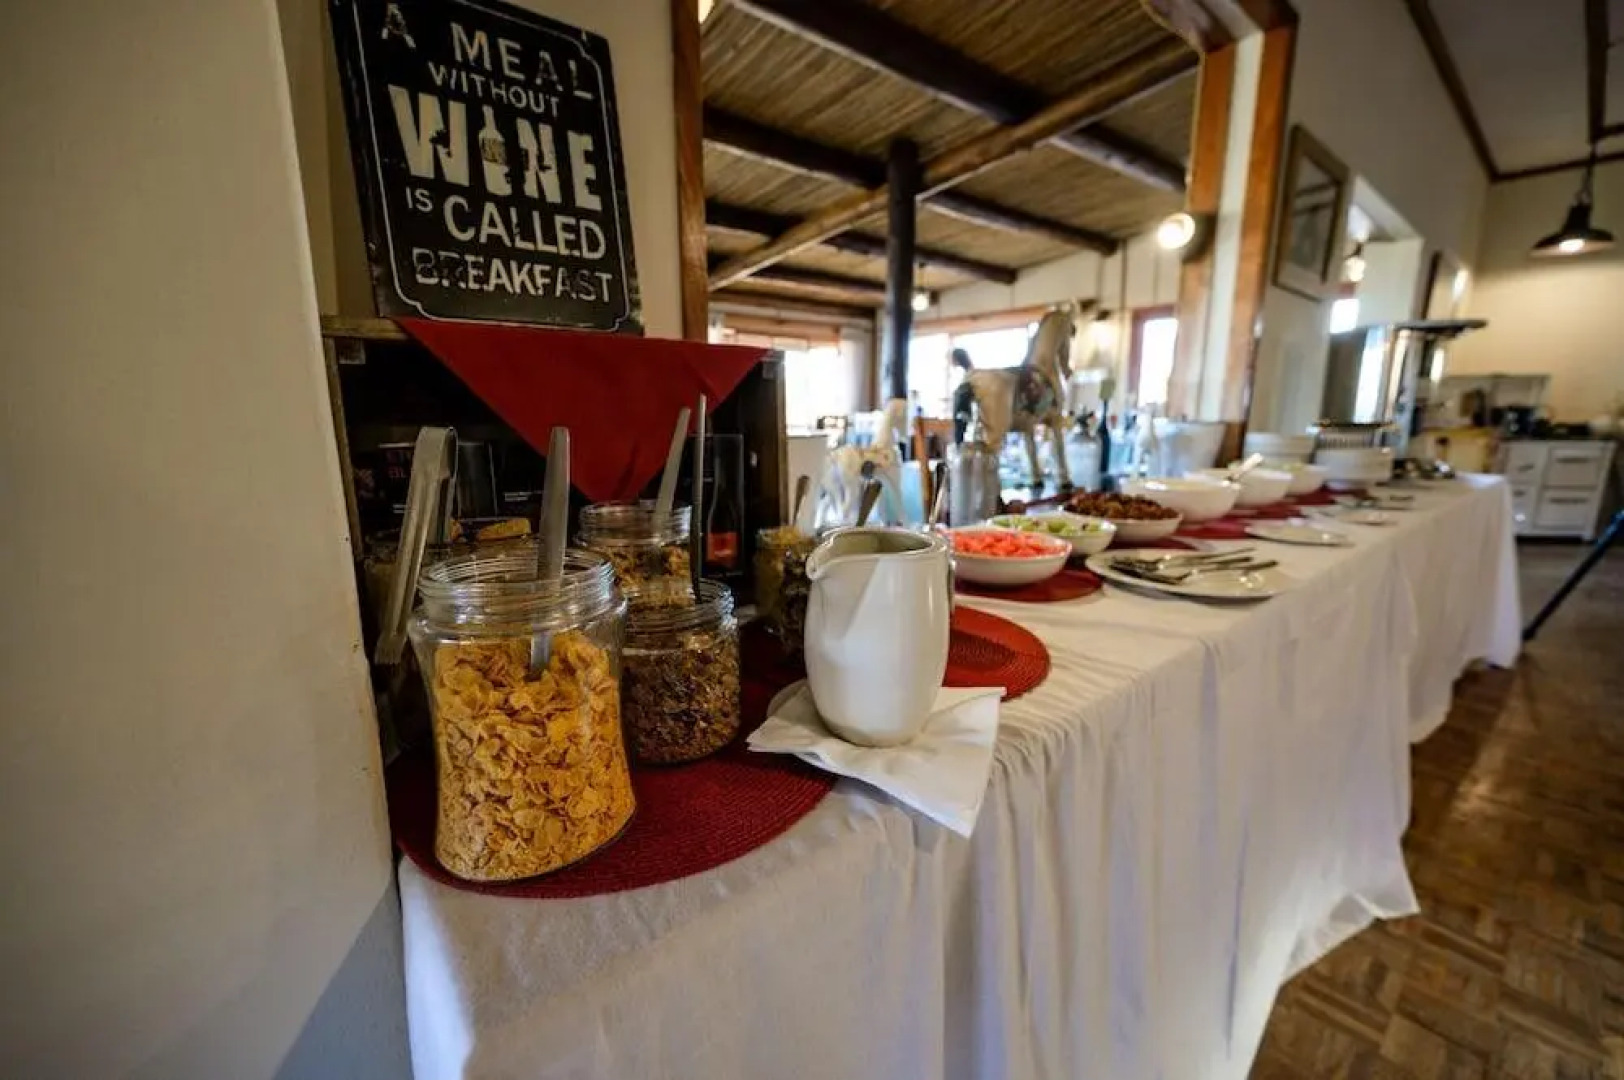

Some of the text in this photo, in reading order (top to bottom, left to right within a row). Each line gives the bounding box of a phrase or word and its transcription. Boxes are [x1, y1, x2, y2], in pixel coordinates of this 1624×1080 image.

[381, 2, 594, 100] A MEAL
[427, 61, 560, 117] WITHOUT
[387, 83, 602, 211] WINE
[405, 186, 607, 259] IS CALLED
[412, 247, 612, 302] BREAKFAST
